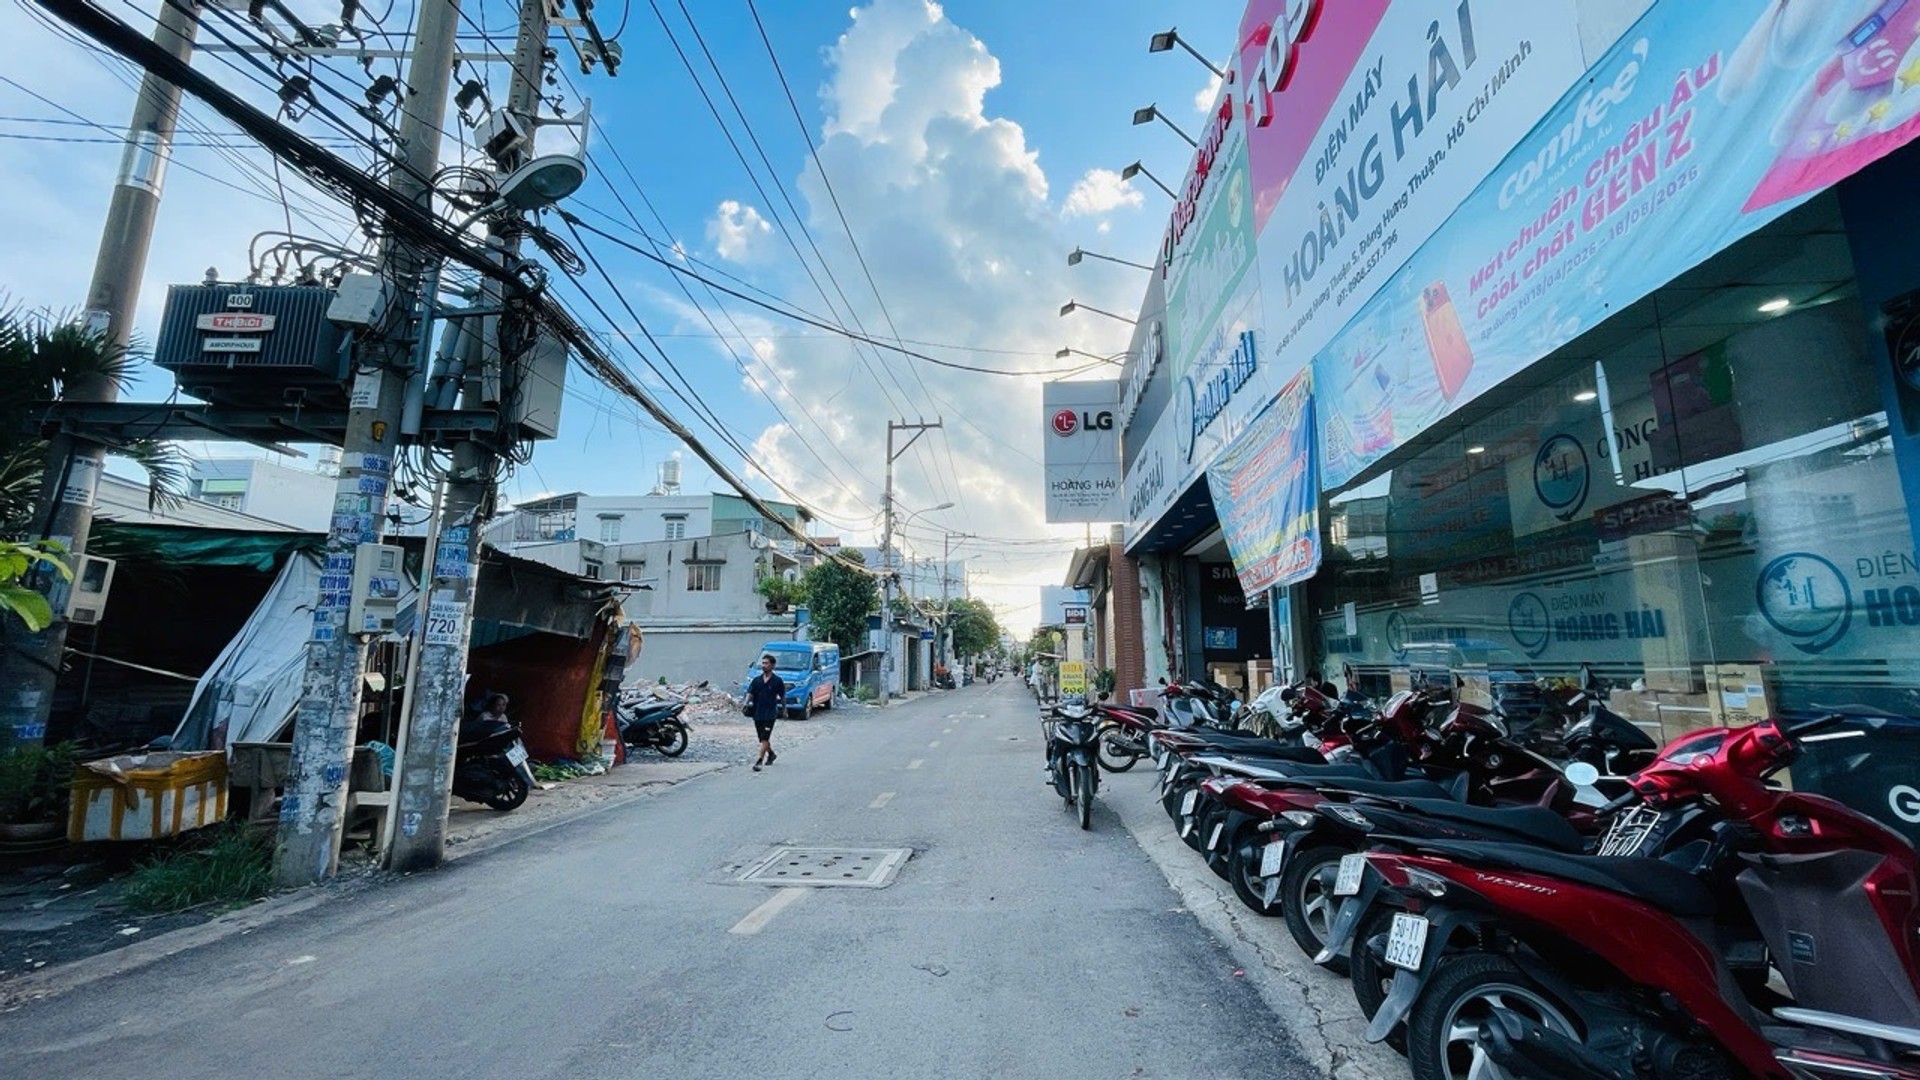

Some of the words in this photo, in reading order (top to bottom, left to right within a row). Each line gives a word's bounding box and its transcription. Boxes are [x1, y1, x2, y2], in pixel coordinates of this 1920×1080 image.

[1466, 90, 1490, 125] Chí
[1491, 39, 1533, 96] Minh
[1315, 124, 1347, 186] ĐIỆN
[1350, 55, 1384, 131] MÁY
[1283, 133, 1386, 308] HOÀNG
[1390, 0, 1477, 162] HẢI
[1506, 187, 1578, 260] chuẩn
[1585, 105, 1661, 188] châu
[1668, 51, 1720, 116] Âu
[1523, 219, 1576, 279] chất
[1582, 139, 1657, 232] GEN
[1665, 109, 1692, 169] Z
[228, 295, 252, 306] 400
[1083, 411, 1113, 431] LG
[1051, 478, 1092, 491] HOÀNG
[1096, 476, 1116, 490] HẢI
[429, 618, 456, 634] 720
[1624, 602, 1666, 639] HẢI
